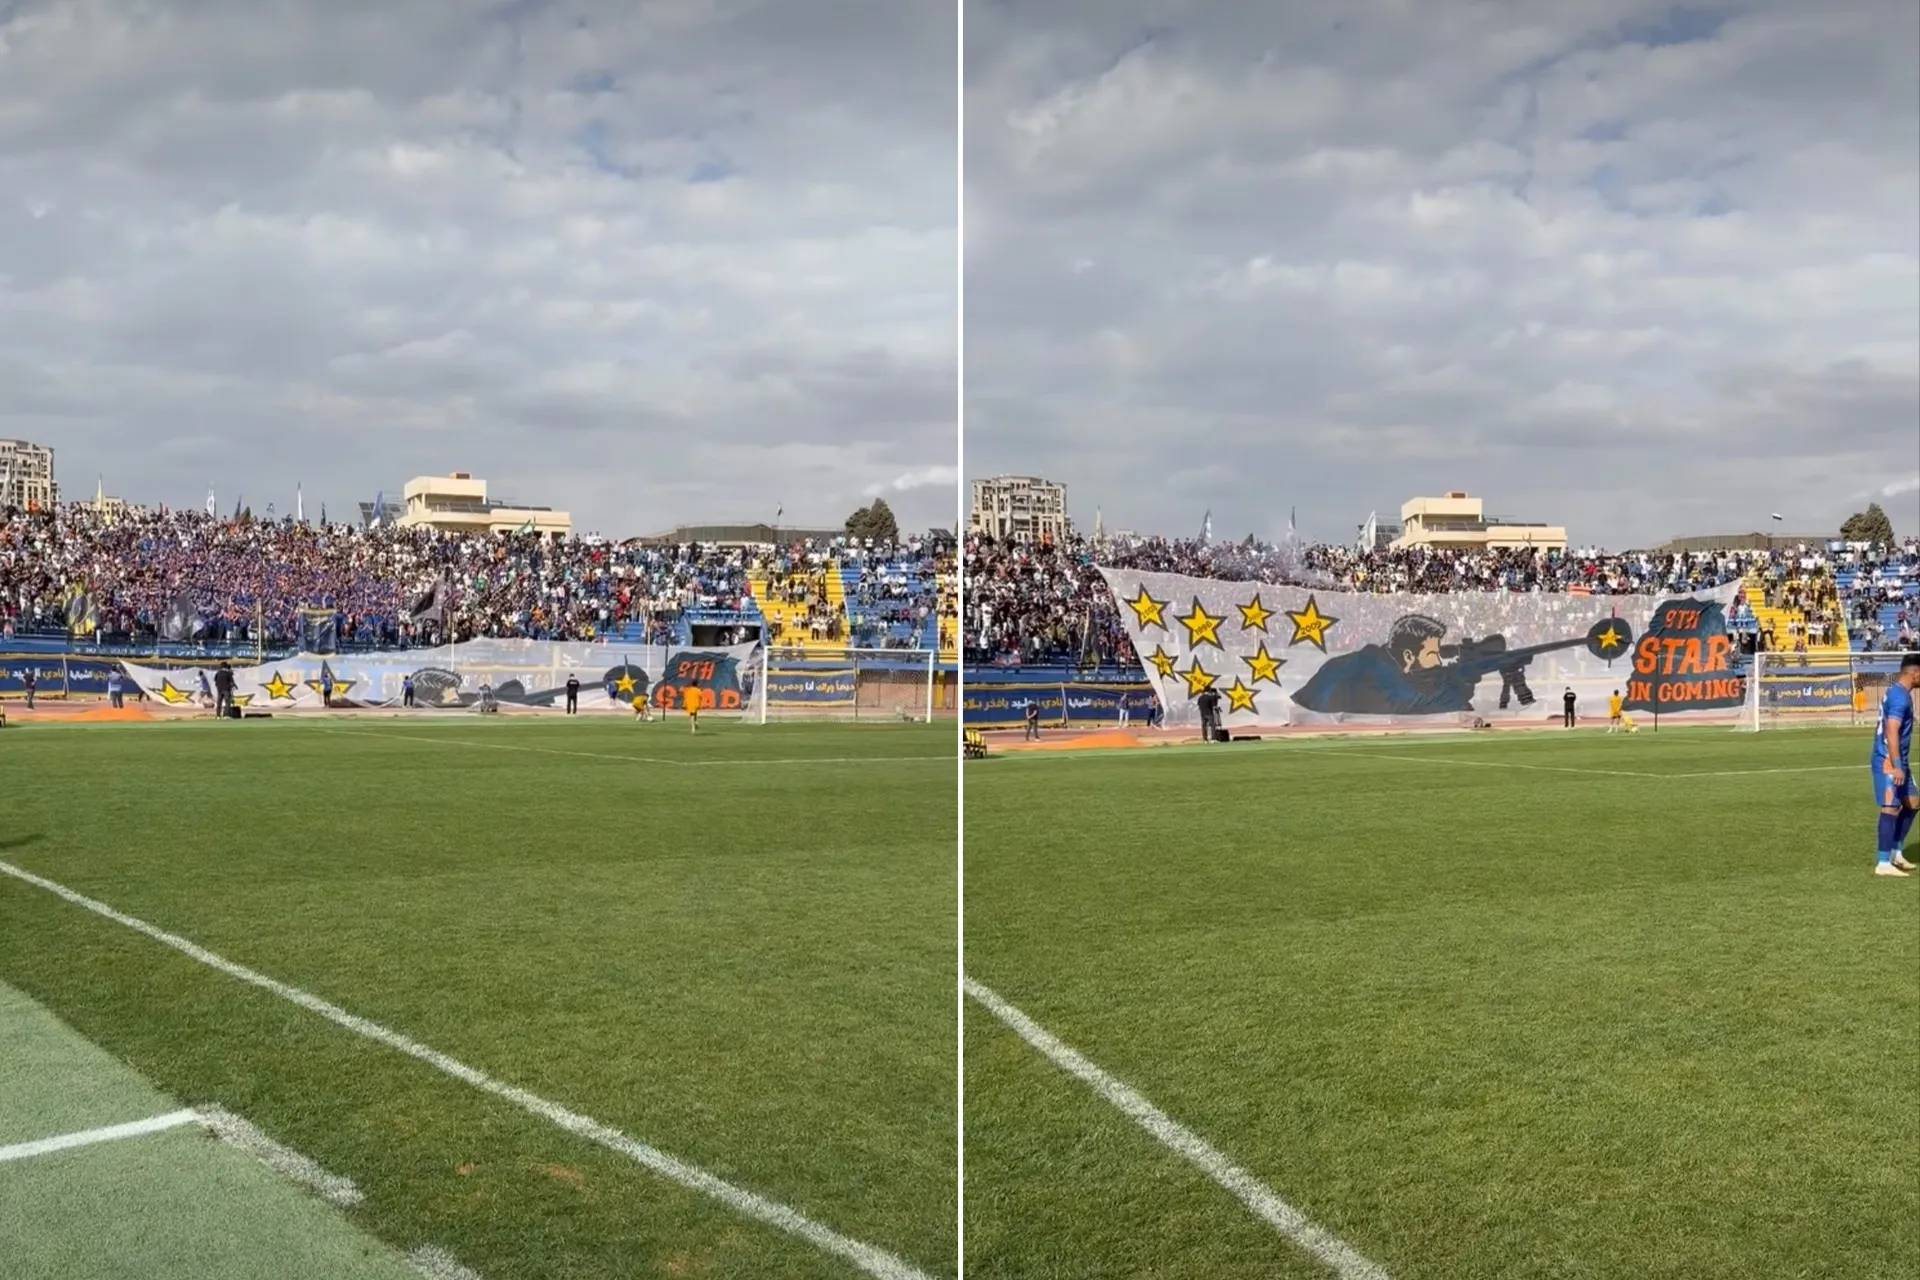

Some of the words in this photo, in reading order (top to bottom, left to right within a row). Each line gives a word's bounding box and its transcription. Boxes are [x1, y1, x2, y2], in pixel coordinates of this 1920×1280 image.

[1299, 620, 1322, 636] 2009
[1665, 608, 1701, 630] 9TH
[1635, 634, 1731, 676] STAR
[677, 660, 716, 681] 9TH
[1628, 680, 1652, 702] IN
[1657, 679, 1741, 702] COMING
